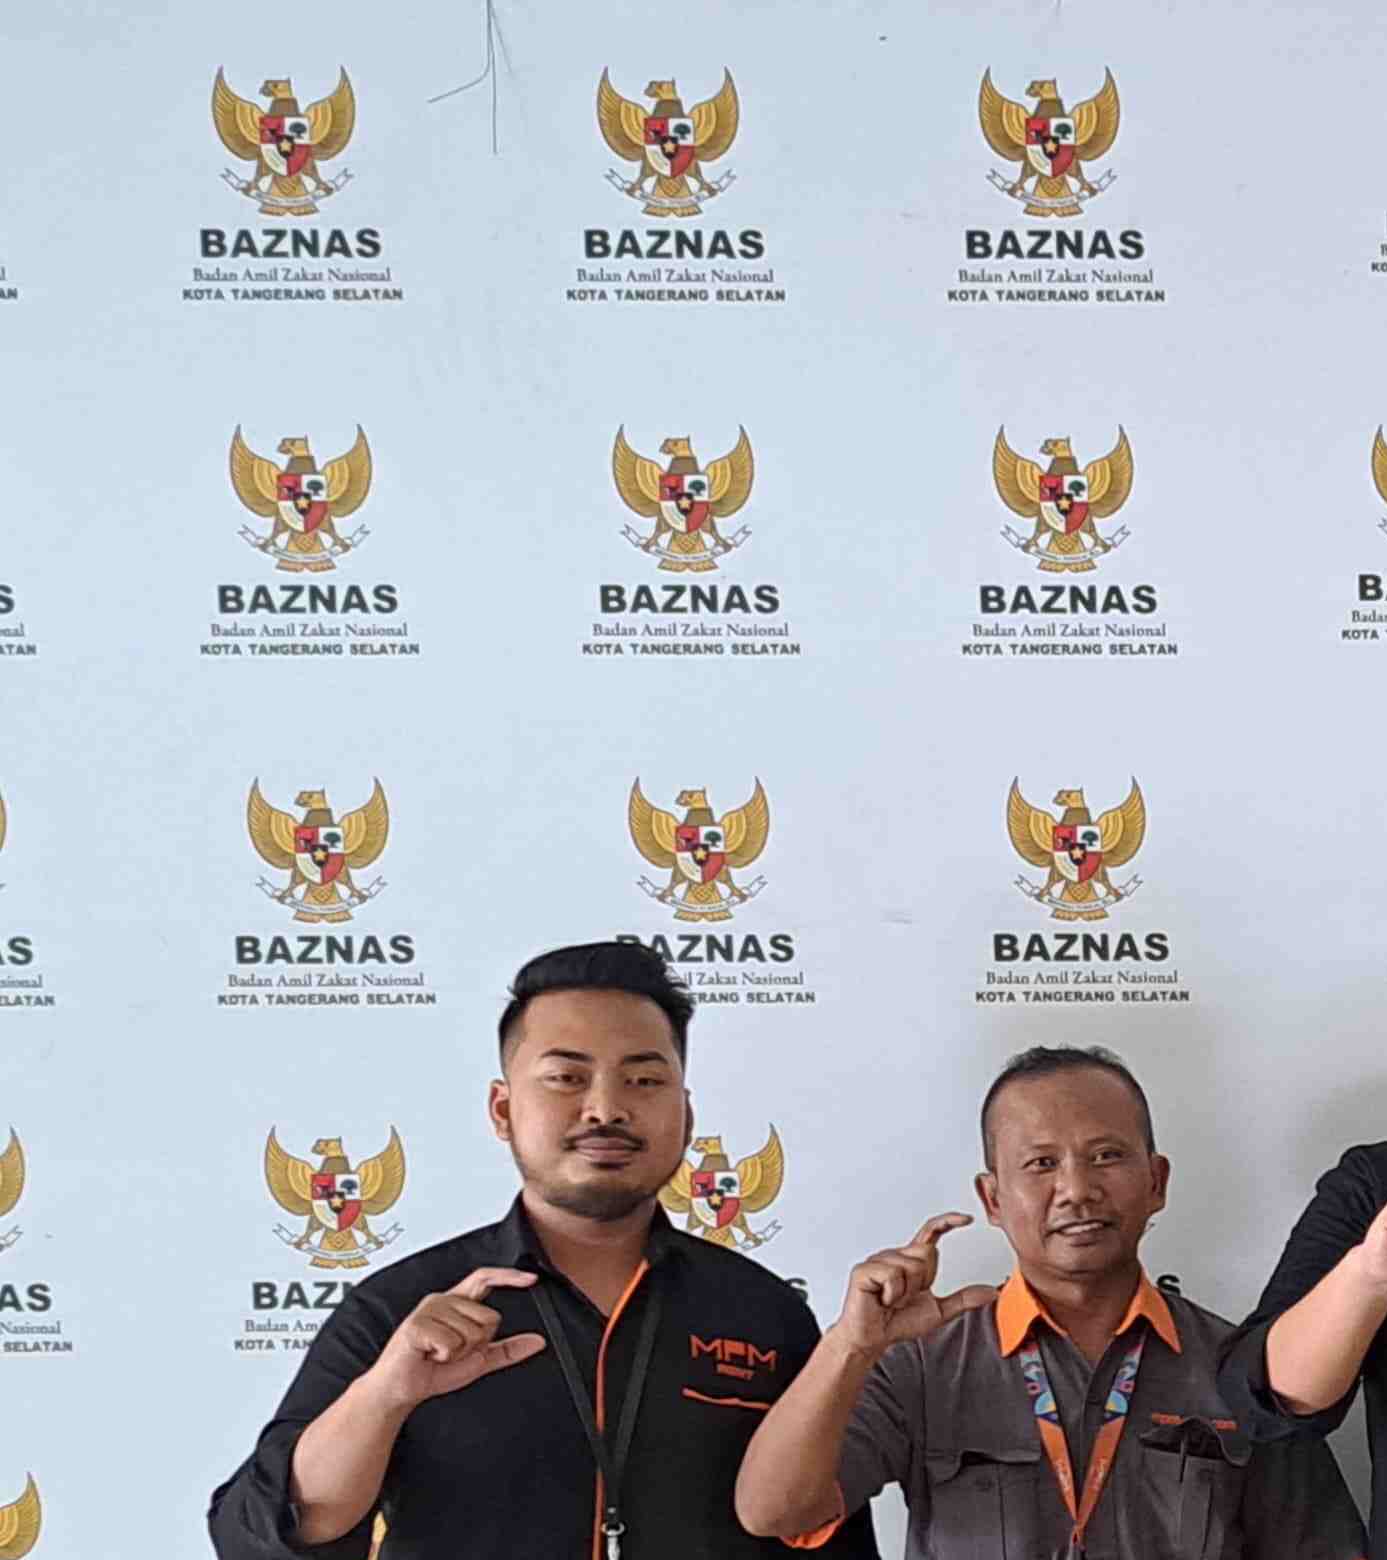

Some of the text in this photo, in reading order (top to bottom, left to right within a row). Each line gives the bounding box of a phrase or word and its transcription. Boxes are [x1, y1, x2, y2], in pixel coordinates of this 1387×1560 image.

[200, 228, 382, 258] BAZNAS
[193, 268, 392, 281] Badan Amil Zakat Nasional
[182, 289, 403, 300] KOTA TANGERANG SELATAN
[994, 933, 1169, 961] BAZNAS
[986, 970, 1178, 984] Badan Amil Zakat Nasional
[976, 990, 1190, 1002] KOTA TANGERANG SELATAN
